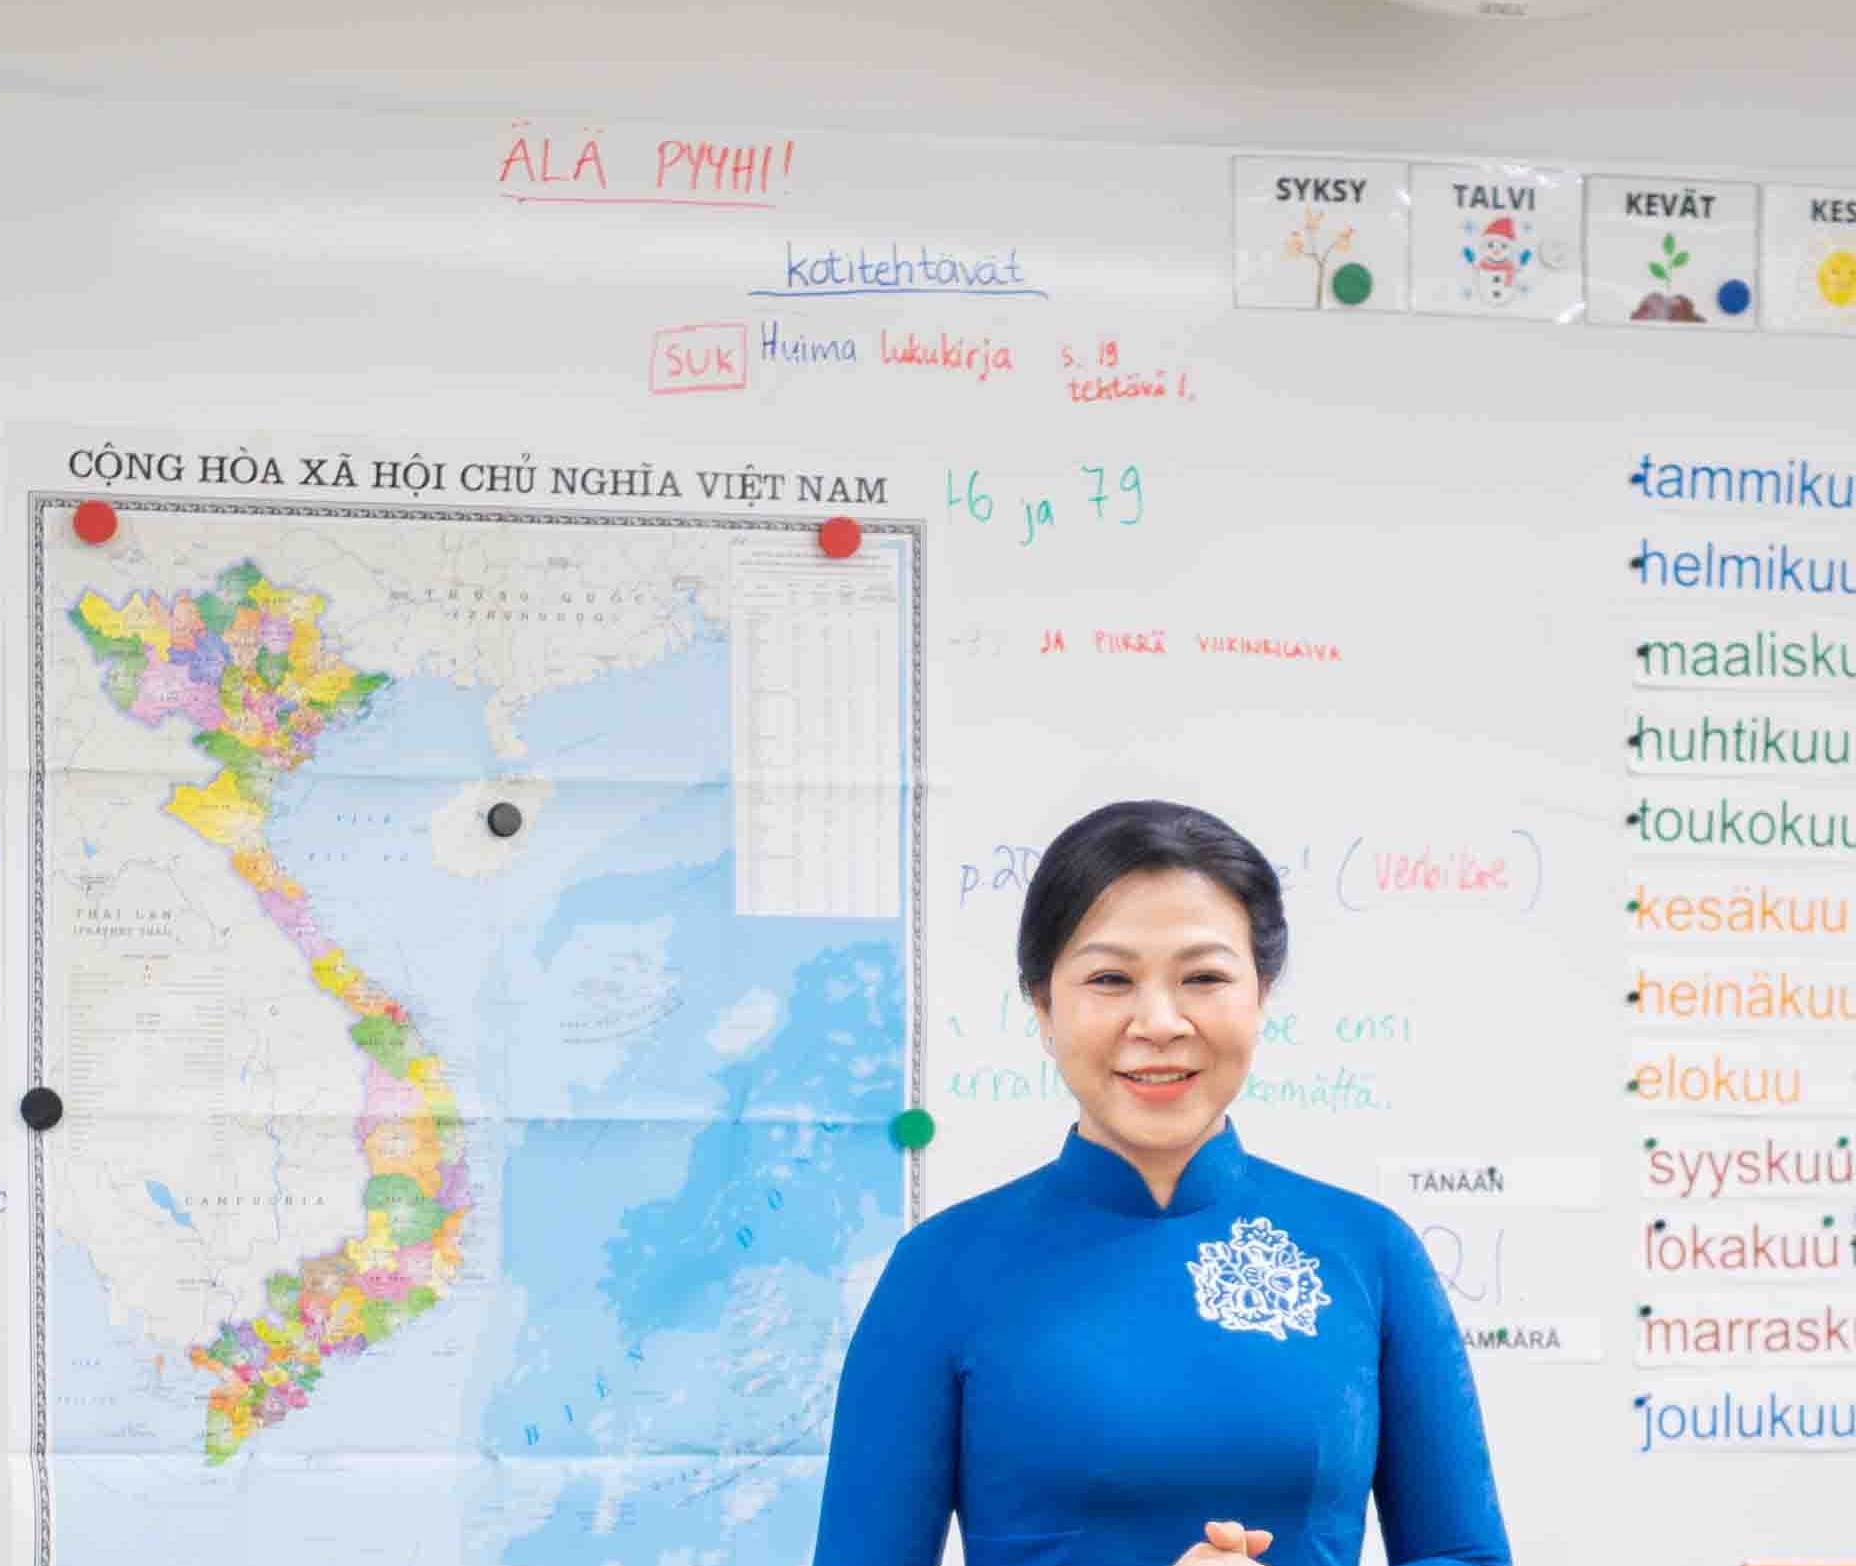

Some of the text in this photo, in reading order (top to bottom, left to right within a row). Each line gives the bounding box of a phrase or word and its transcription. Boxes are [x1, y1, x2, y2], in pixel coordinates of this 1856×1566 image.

[498, 121, 796, 197] ÄLÄ PYYHI!
[1276, 177, 1367, 203] SYKSY
[1453, 184, 1536, 212] TALVI
[1625, 190, 1716, 220] KEVÄT
[665, 345, 736, 378] SUK
[68, 442, 888, 507] CỘNG HÒA XÃ HỘI CHỦ NGHĨA VIỆT NAM
[1082, 464, 1144, 526] 79
[1636, 715, 1851, 764] huhtikuu
[1635, 883, 1849, 934] kesäkuu
[1634, 1052, 1802, 1103] elokuu
[1648, 1139, 1855, 1198] syyskuu
[1646, 1223, 1840, 1271] lokakuu
[1640, 1392, 1856, 1452] joulukuu
